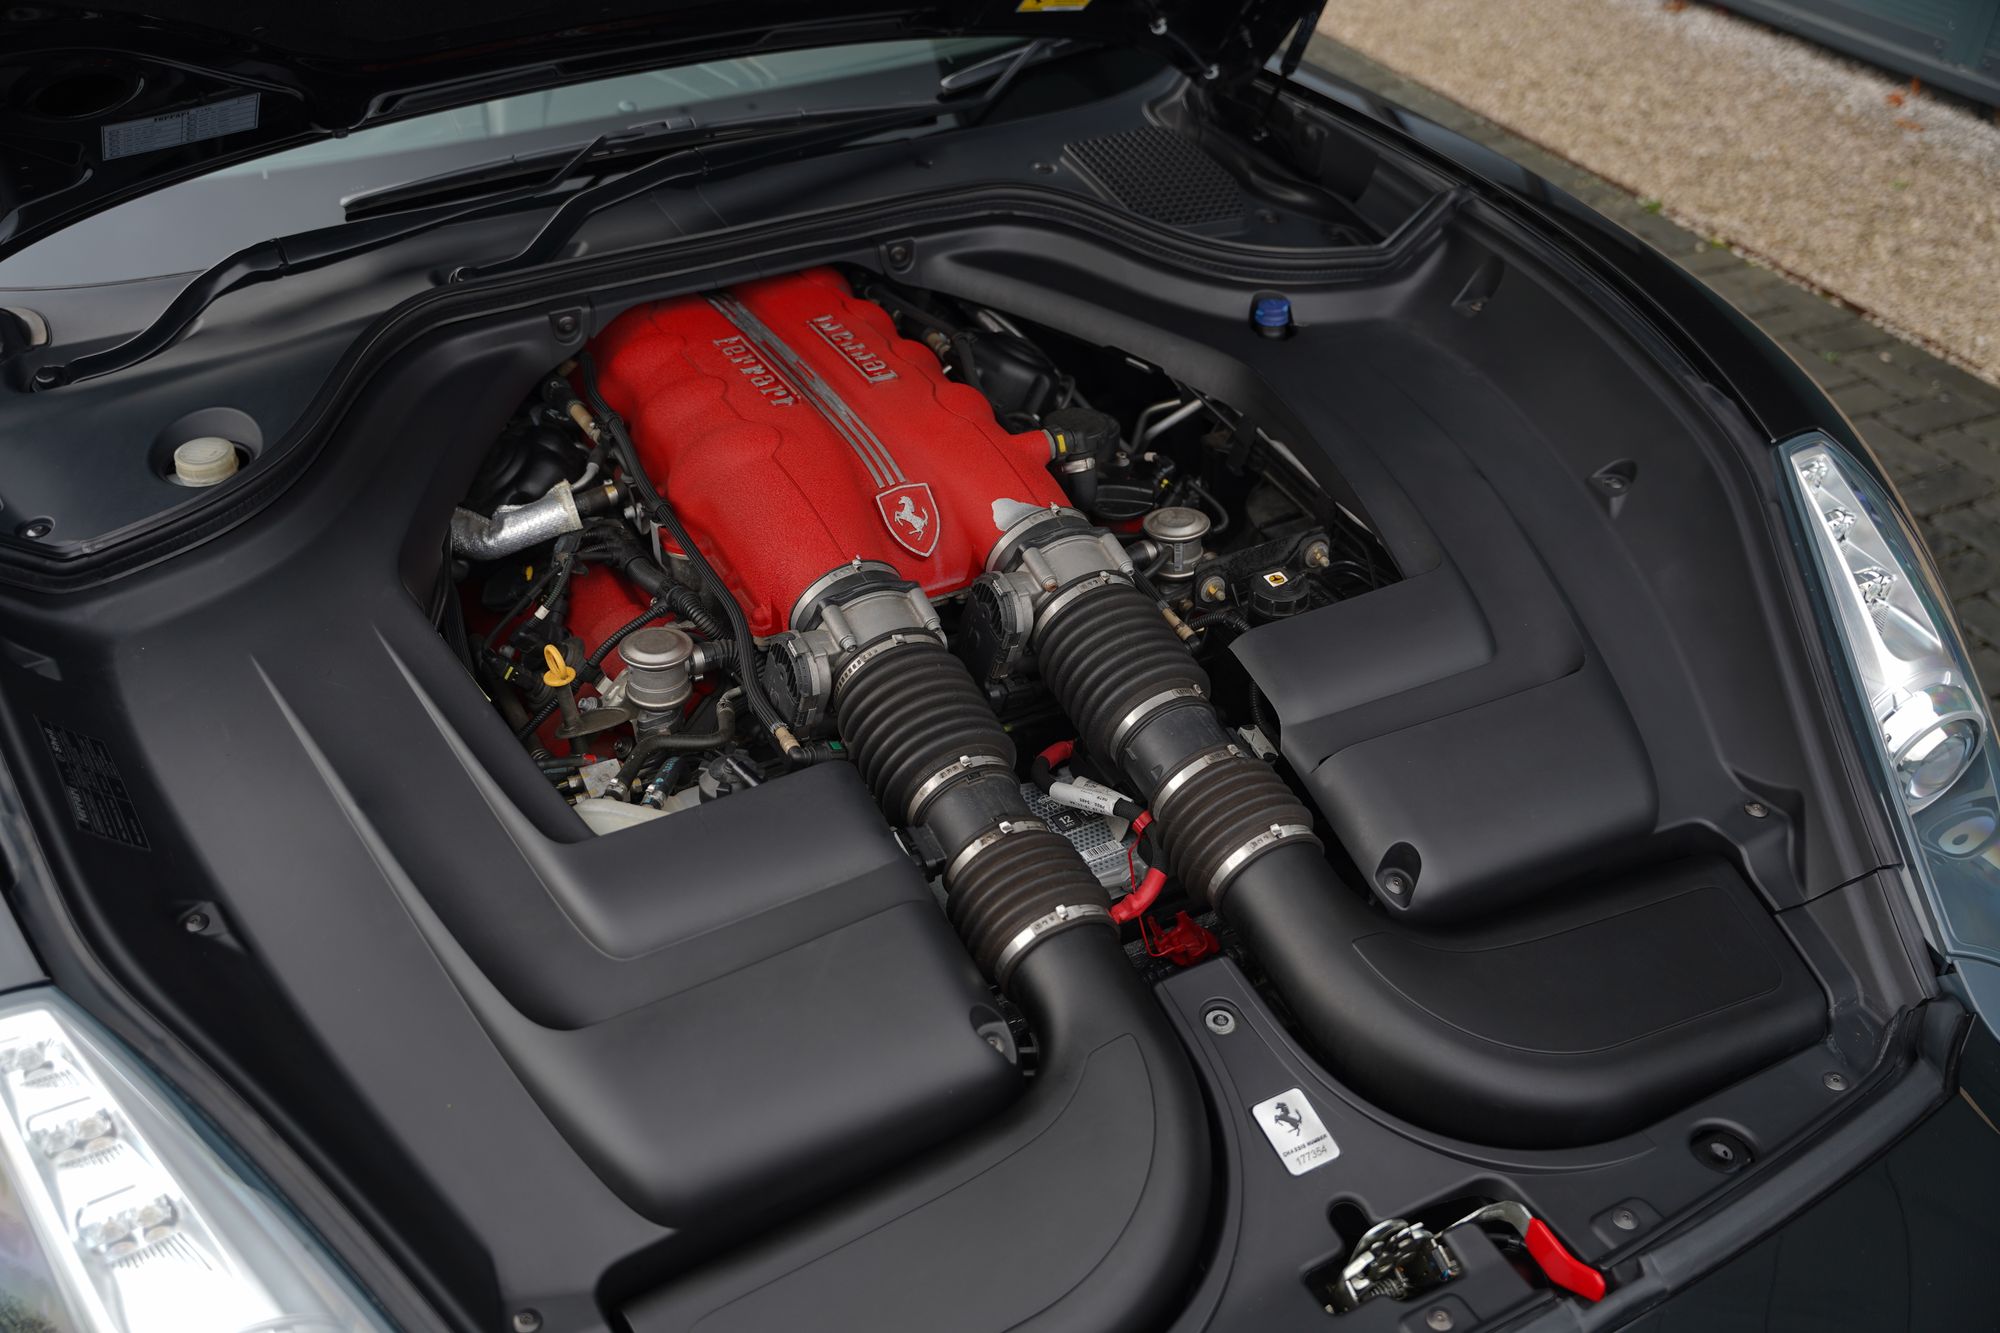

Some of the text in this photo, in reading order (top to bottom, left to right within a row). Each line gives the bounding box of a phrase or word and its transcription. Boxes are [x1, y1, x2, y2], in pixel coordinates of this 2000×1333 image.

[806, 314, 898, 384] Ferrari
[1059, 815, 1074, 824] 12
[1282, 1134, 1327, 1157] CHASSIS NUMBER
[1296, 1146, 1327, 1165] 177354
